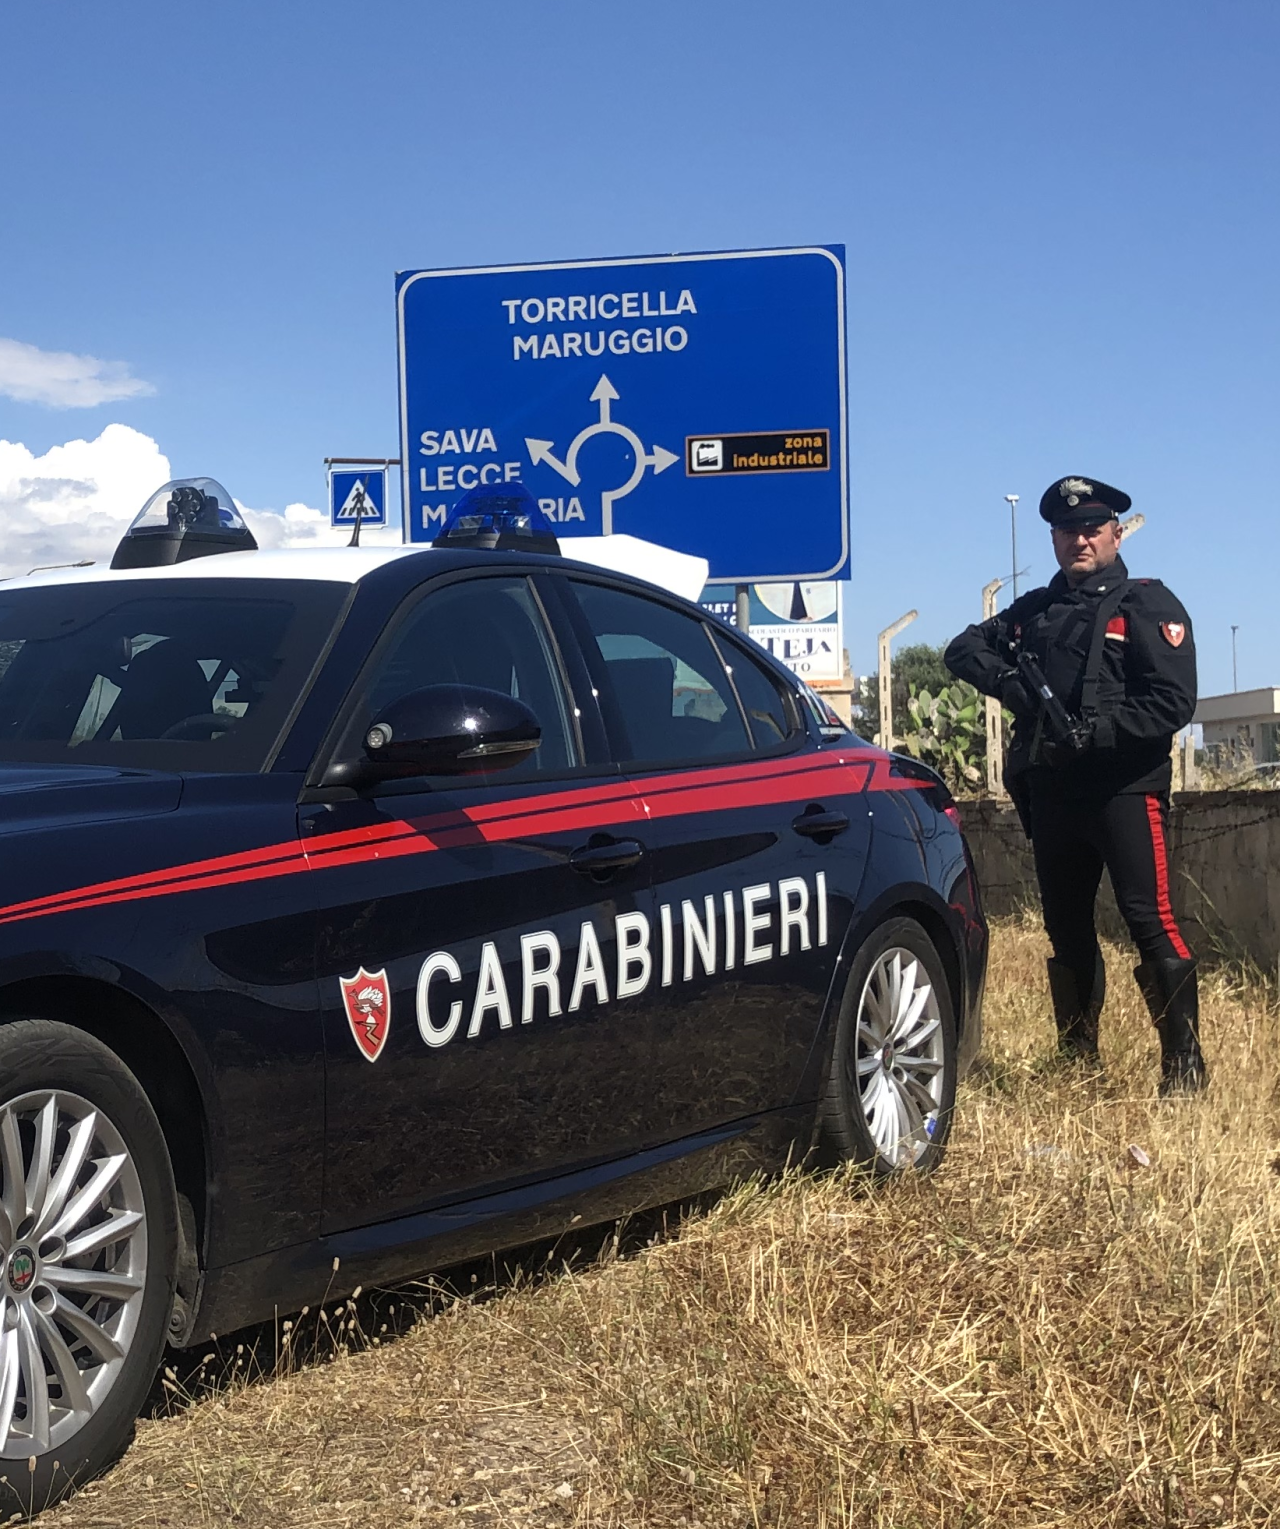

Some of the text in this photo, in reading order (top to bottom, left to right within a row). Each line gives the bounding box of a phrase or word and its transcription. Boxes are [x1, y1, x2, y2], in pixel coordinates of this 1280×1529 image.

[501, 289, 698, 324] TORRICELLA
[513, 325, 688, 360] MARUGGIO
[419, 428, 497, 456] SAVA
[784, 437, 823, 449] zona
[733, 450, 824, 468] industriale
[420, 462, 523, 492] LECCE
[422, 497, 586, 529] MRIA
[415, 871, 829, 1048] CARABINIERI
